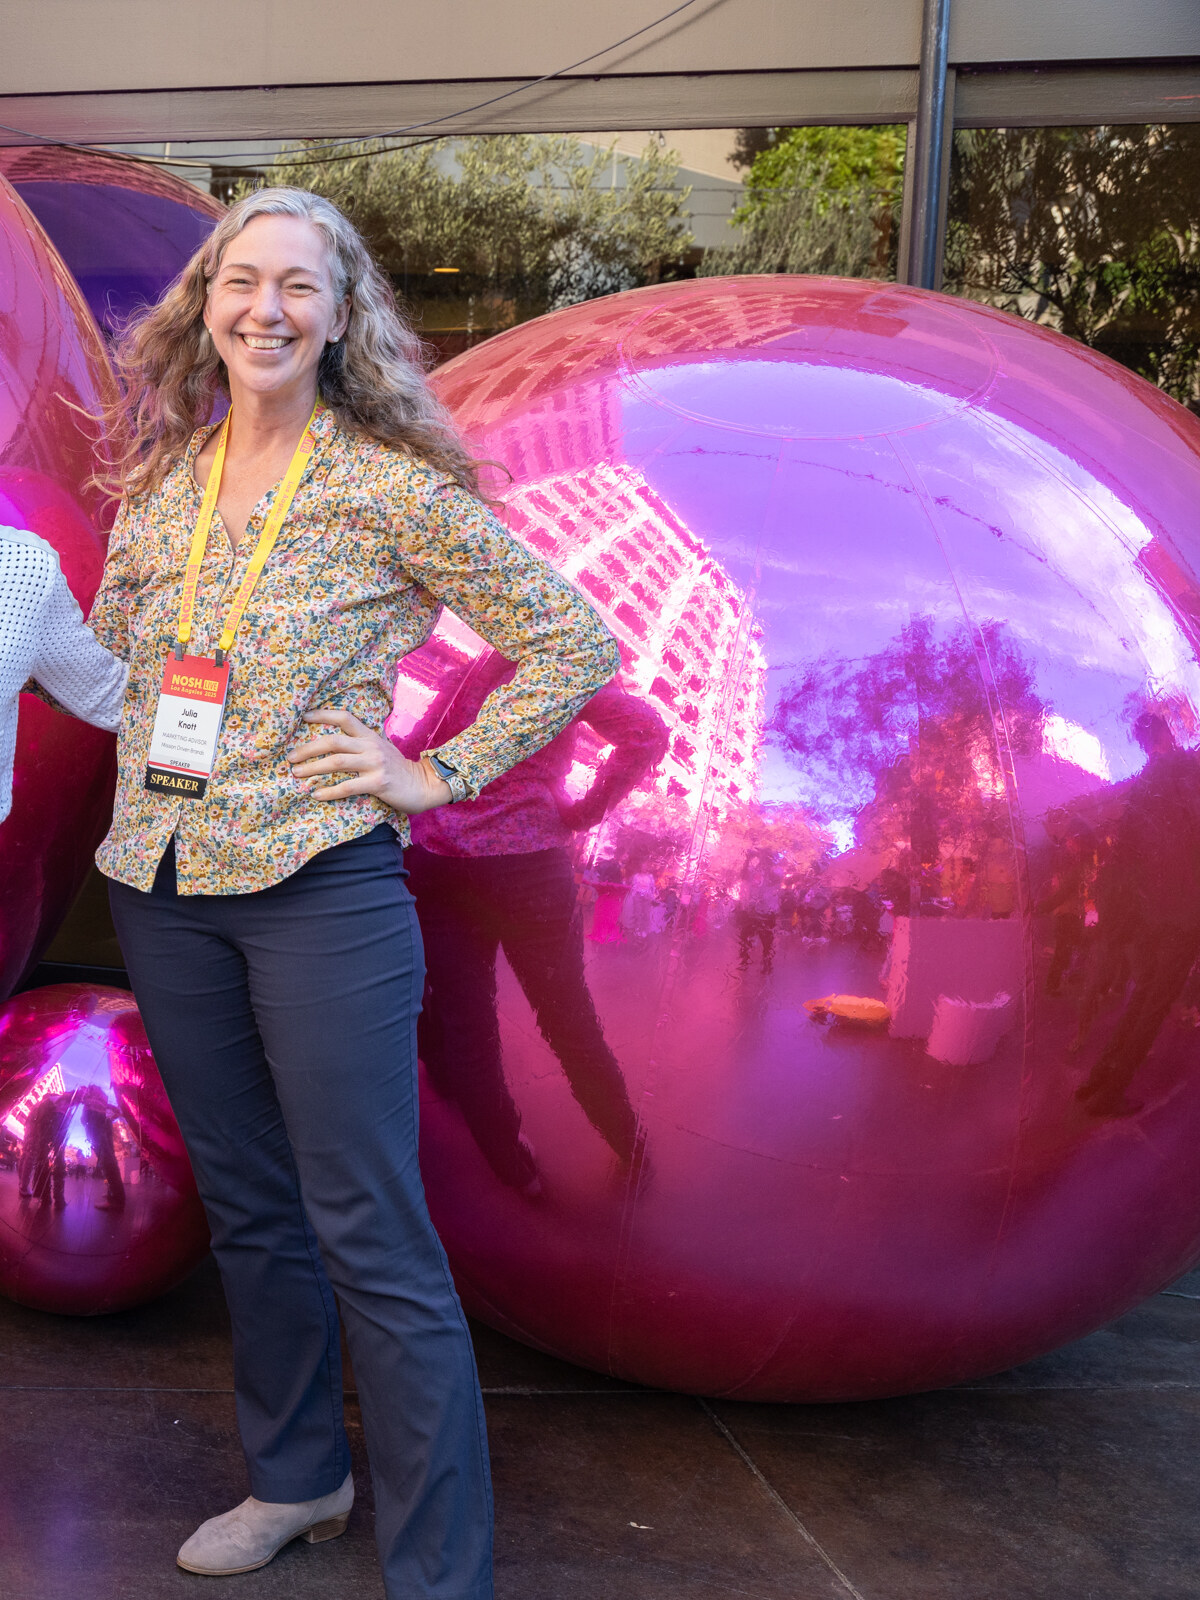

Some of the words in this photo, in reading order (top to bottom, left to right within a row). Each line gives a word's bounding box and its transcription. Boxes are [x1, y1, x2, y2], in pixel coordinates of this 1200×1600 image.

[187, 564, 199, 583] LIVE
[235, 572, 257, 609] NOSH
[181, 584, 194, 623] NOSH
[226, 611, 240, 630] LIVE
[172, 674, 203, 689] NOSH
[203, 679, 219, 692] LIVE
[181, 687, 203, 696] Angeles
[181, 708, 198, 718] Julia
[178, 720, 197, 731] Knott
[162, 732, 188, 742] MARKETING
[188, 738, 208, 746] ADVISOR
[169, 760, 191, 768] SPEAKER
[150, 773, 199, 792] SPEAKER
